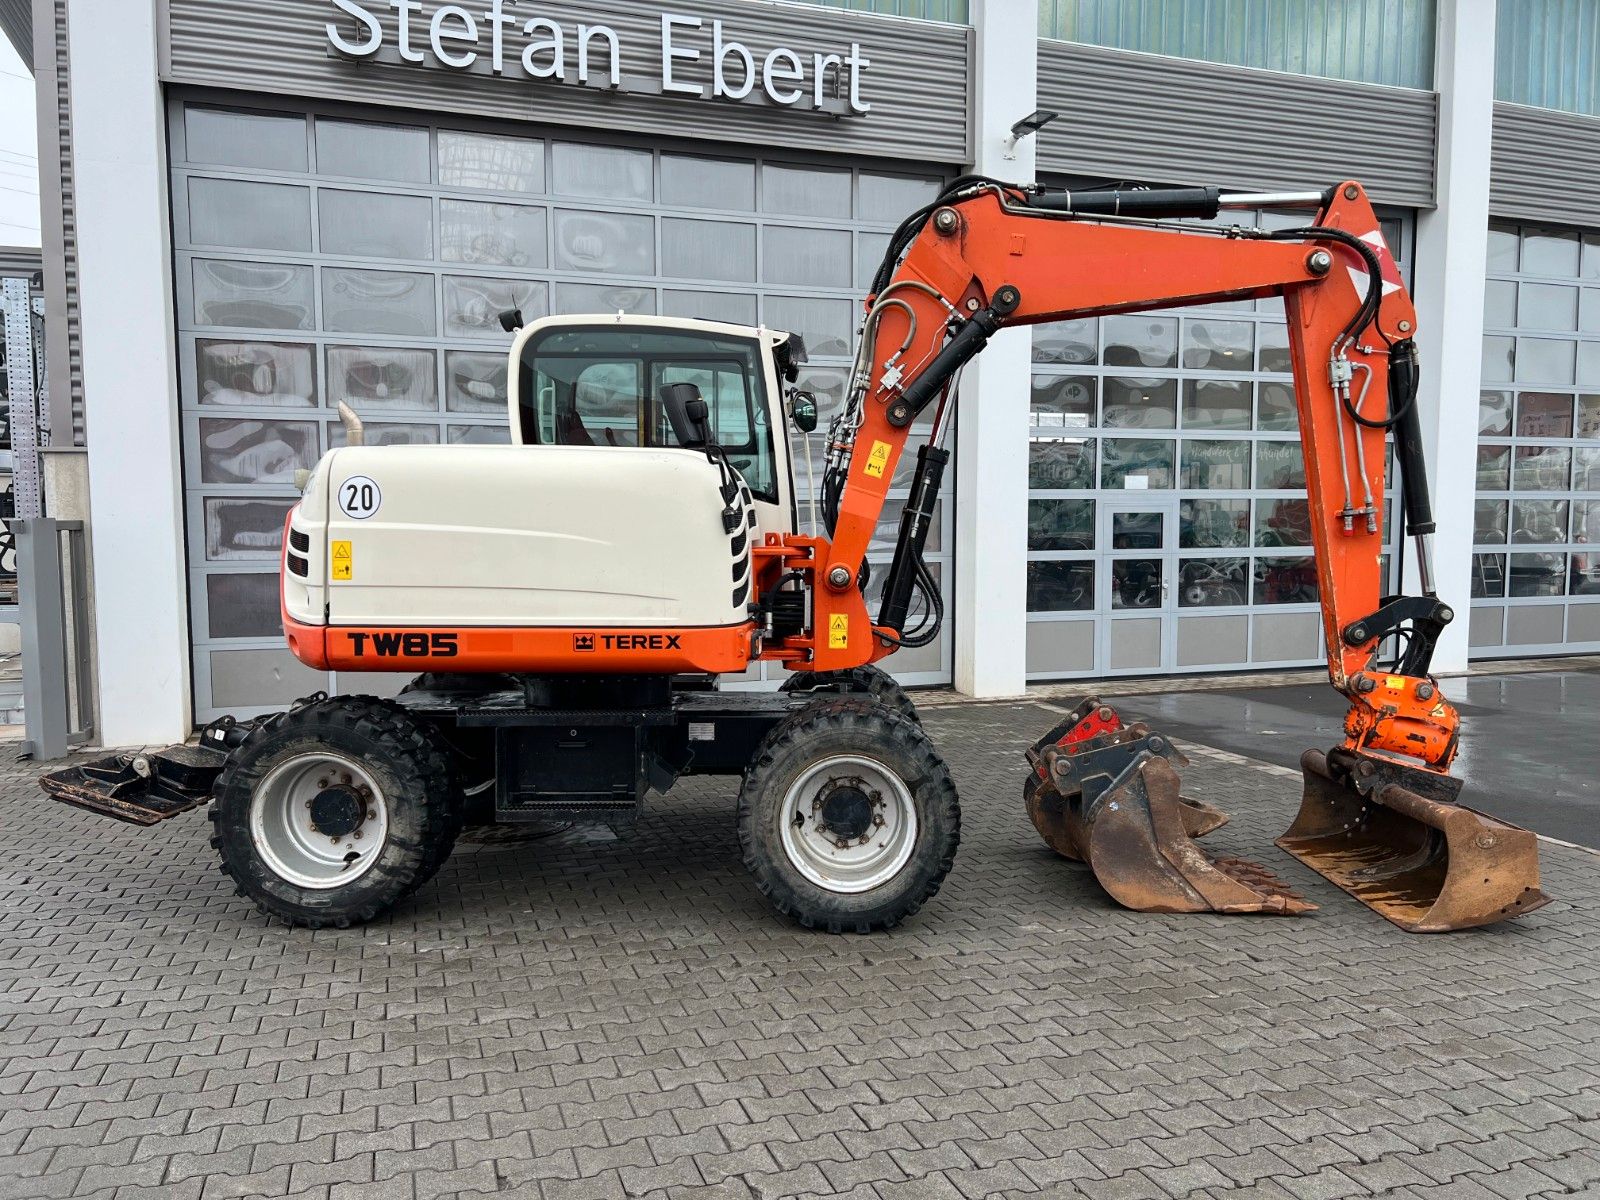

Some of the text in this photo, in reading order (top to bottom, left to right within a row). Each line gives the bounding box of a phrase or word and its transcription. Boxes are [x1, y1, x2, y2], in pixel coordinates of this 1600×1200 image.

[325, 0, 871, 115] Stefan Ebert
[346, 484, 373, 511] 20
[347, 632, 458, 657] TW85
[600, 634, 681, 650] TEREX
